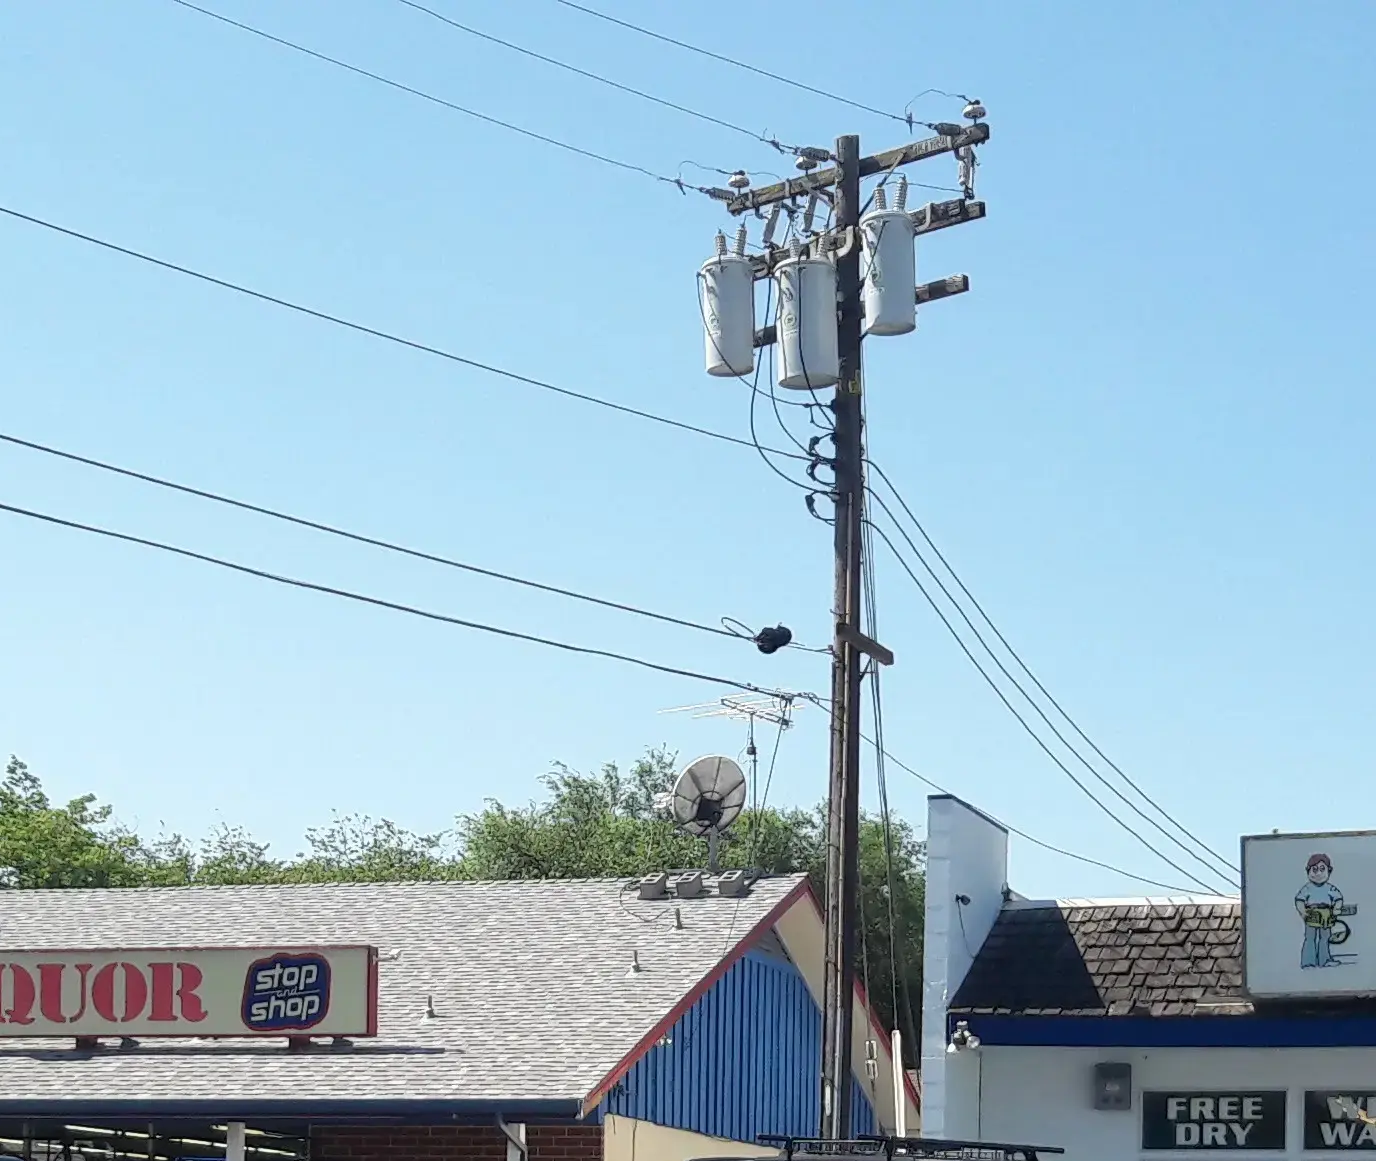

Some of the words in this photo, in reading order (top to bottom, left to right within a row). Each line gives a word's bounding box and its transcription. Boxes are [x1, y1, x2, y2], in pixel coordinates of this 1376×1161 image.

[255, 963, 318, 990] stop
[276, 986, 298, 998] and
[250, 996, 320, 1021] shop
[1167, 1096, 1263, 1120] FREE
[1175, 1122, 1254, 1146] DRY
